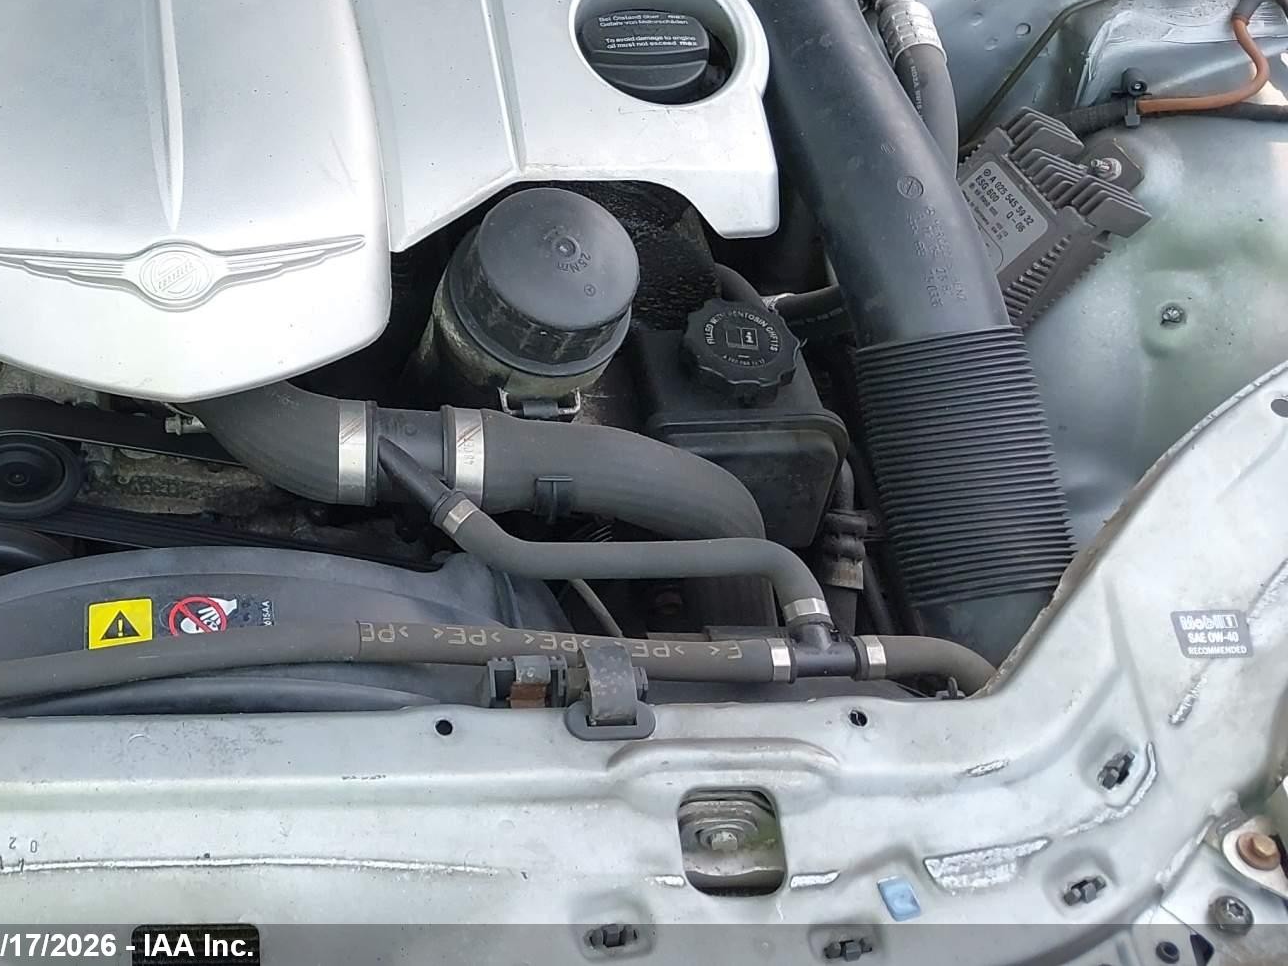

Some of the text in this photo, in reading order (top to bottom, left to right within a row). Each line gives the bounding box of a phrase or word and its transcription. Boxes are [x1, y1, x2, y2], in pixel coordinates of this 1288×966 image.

[975, 175, 989, 191] ESG
[1005, 194, 1019, 208] 545
[1187, 631, 1239, 643] SAE 0W-40
[1187, 645, 1248, 655] RECOMMENDED
